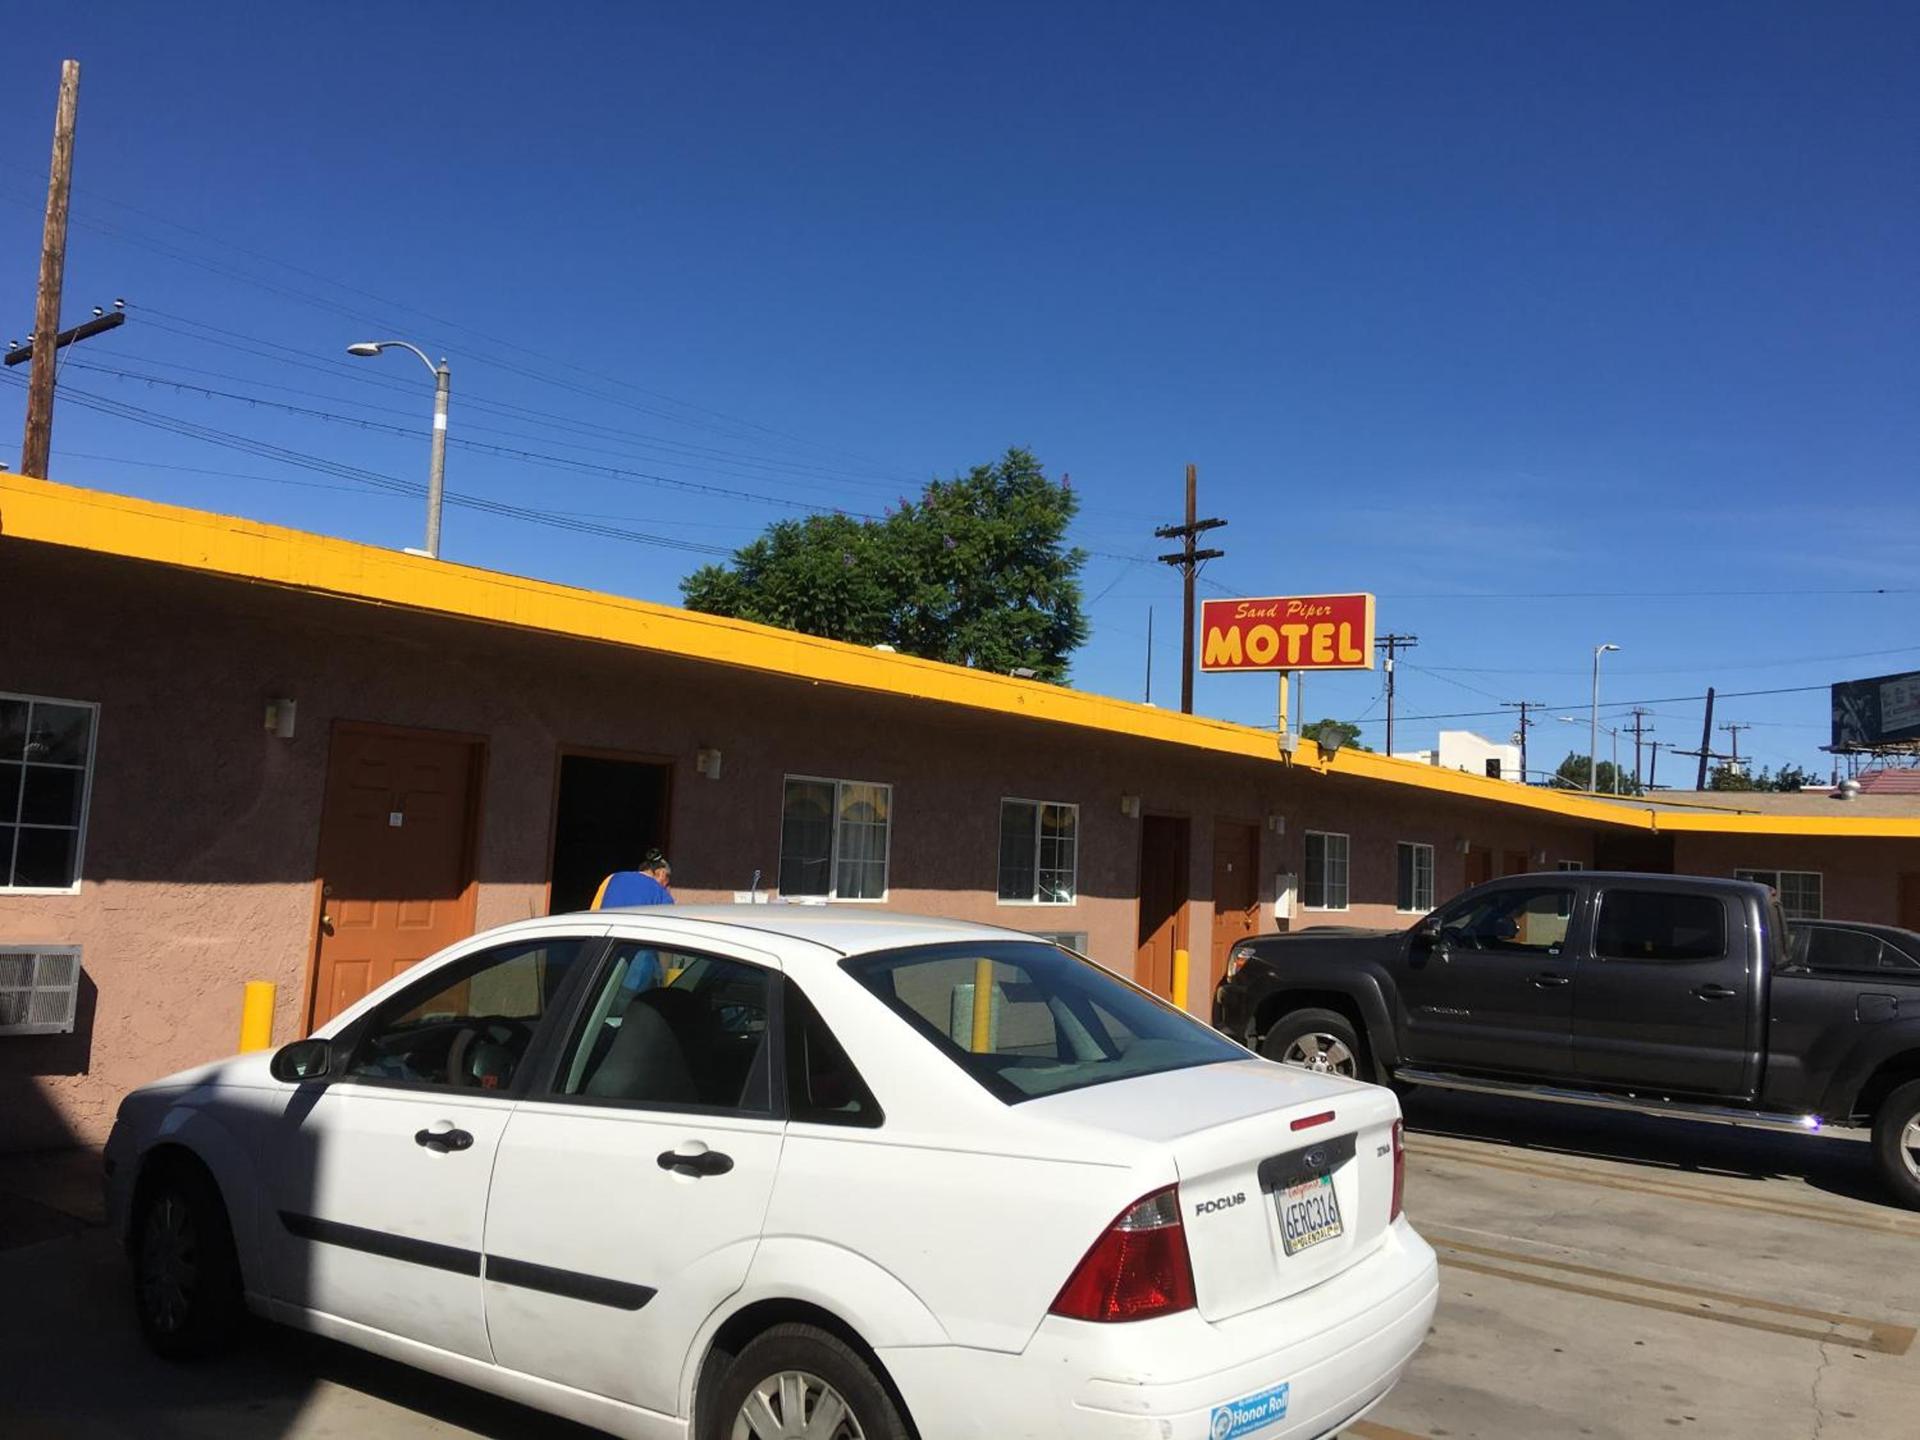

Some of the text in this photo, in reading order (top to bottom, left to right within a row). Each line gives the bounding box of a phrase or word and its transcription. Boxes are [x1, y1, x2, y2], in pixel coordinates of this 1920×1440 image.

[1234, 600, 1331, 620] Sand Piper
[1204, 621, 1363, 666] MOTEL
[1195, 1192, 1246, 1216] FOCUS
[1285, 1195, 1337, 1240] 6ERC316
[1232, 1403, 1268, 1426] Honor
[1268, 1391, 1287, 1414] Roll
